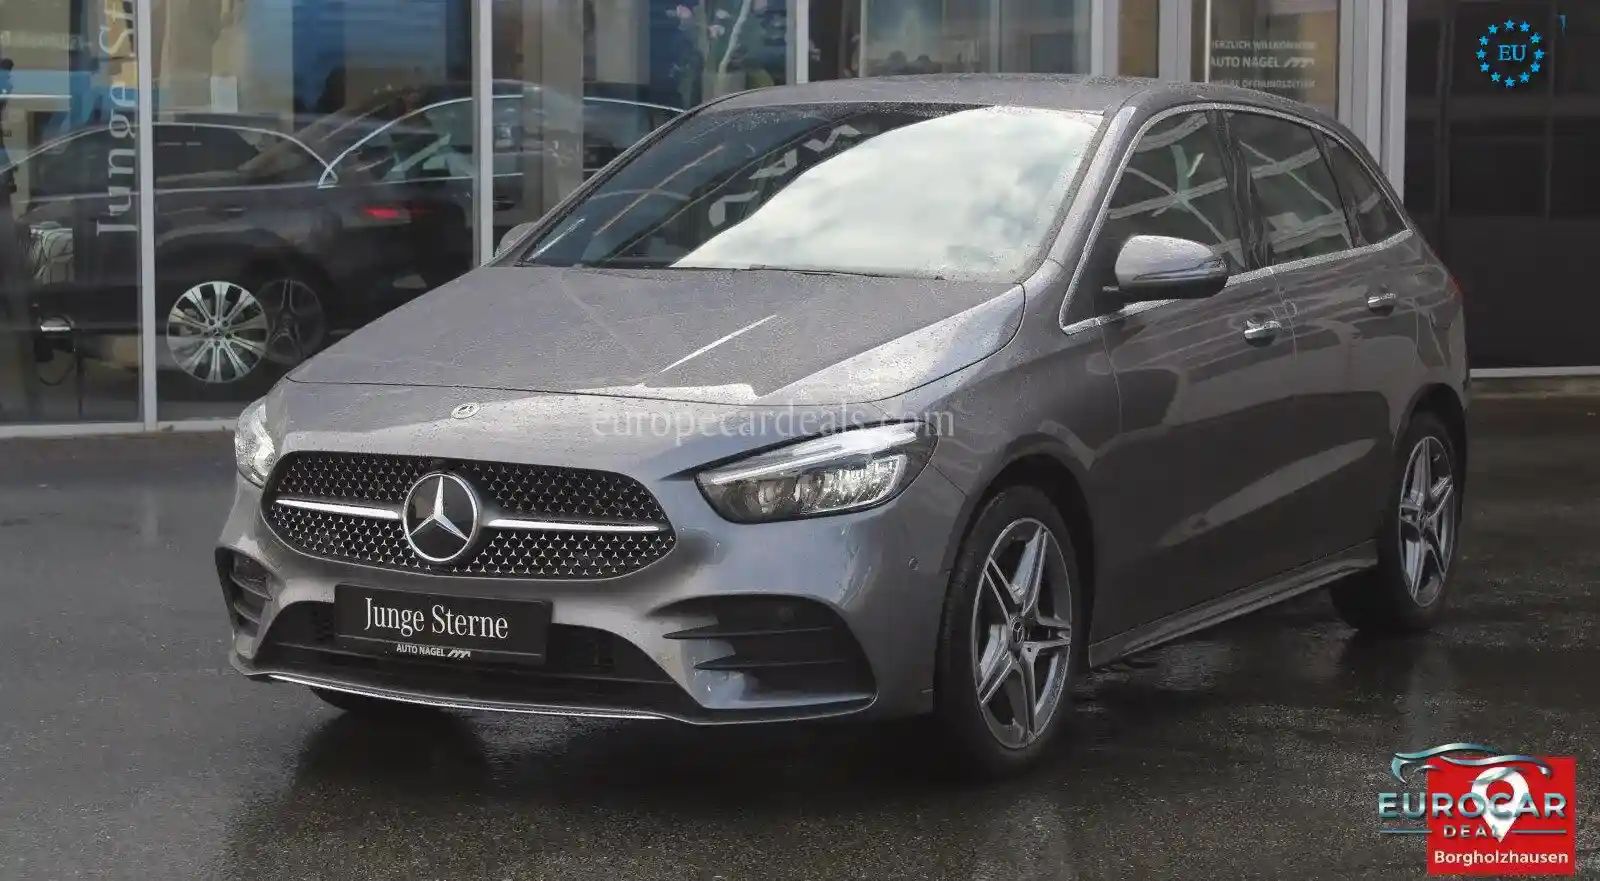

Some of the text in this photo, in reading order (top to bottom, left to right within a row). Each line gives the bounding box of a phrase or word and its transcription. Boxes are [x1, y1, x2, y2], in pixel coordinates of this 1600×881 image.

[364, 597, 509, 639] Junge Sterne
[396, 644, 446, 657] AUTO NAGEL
